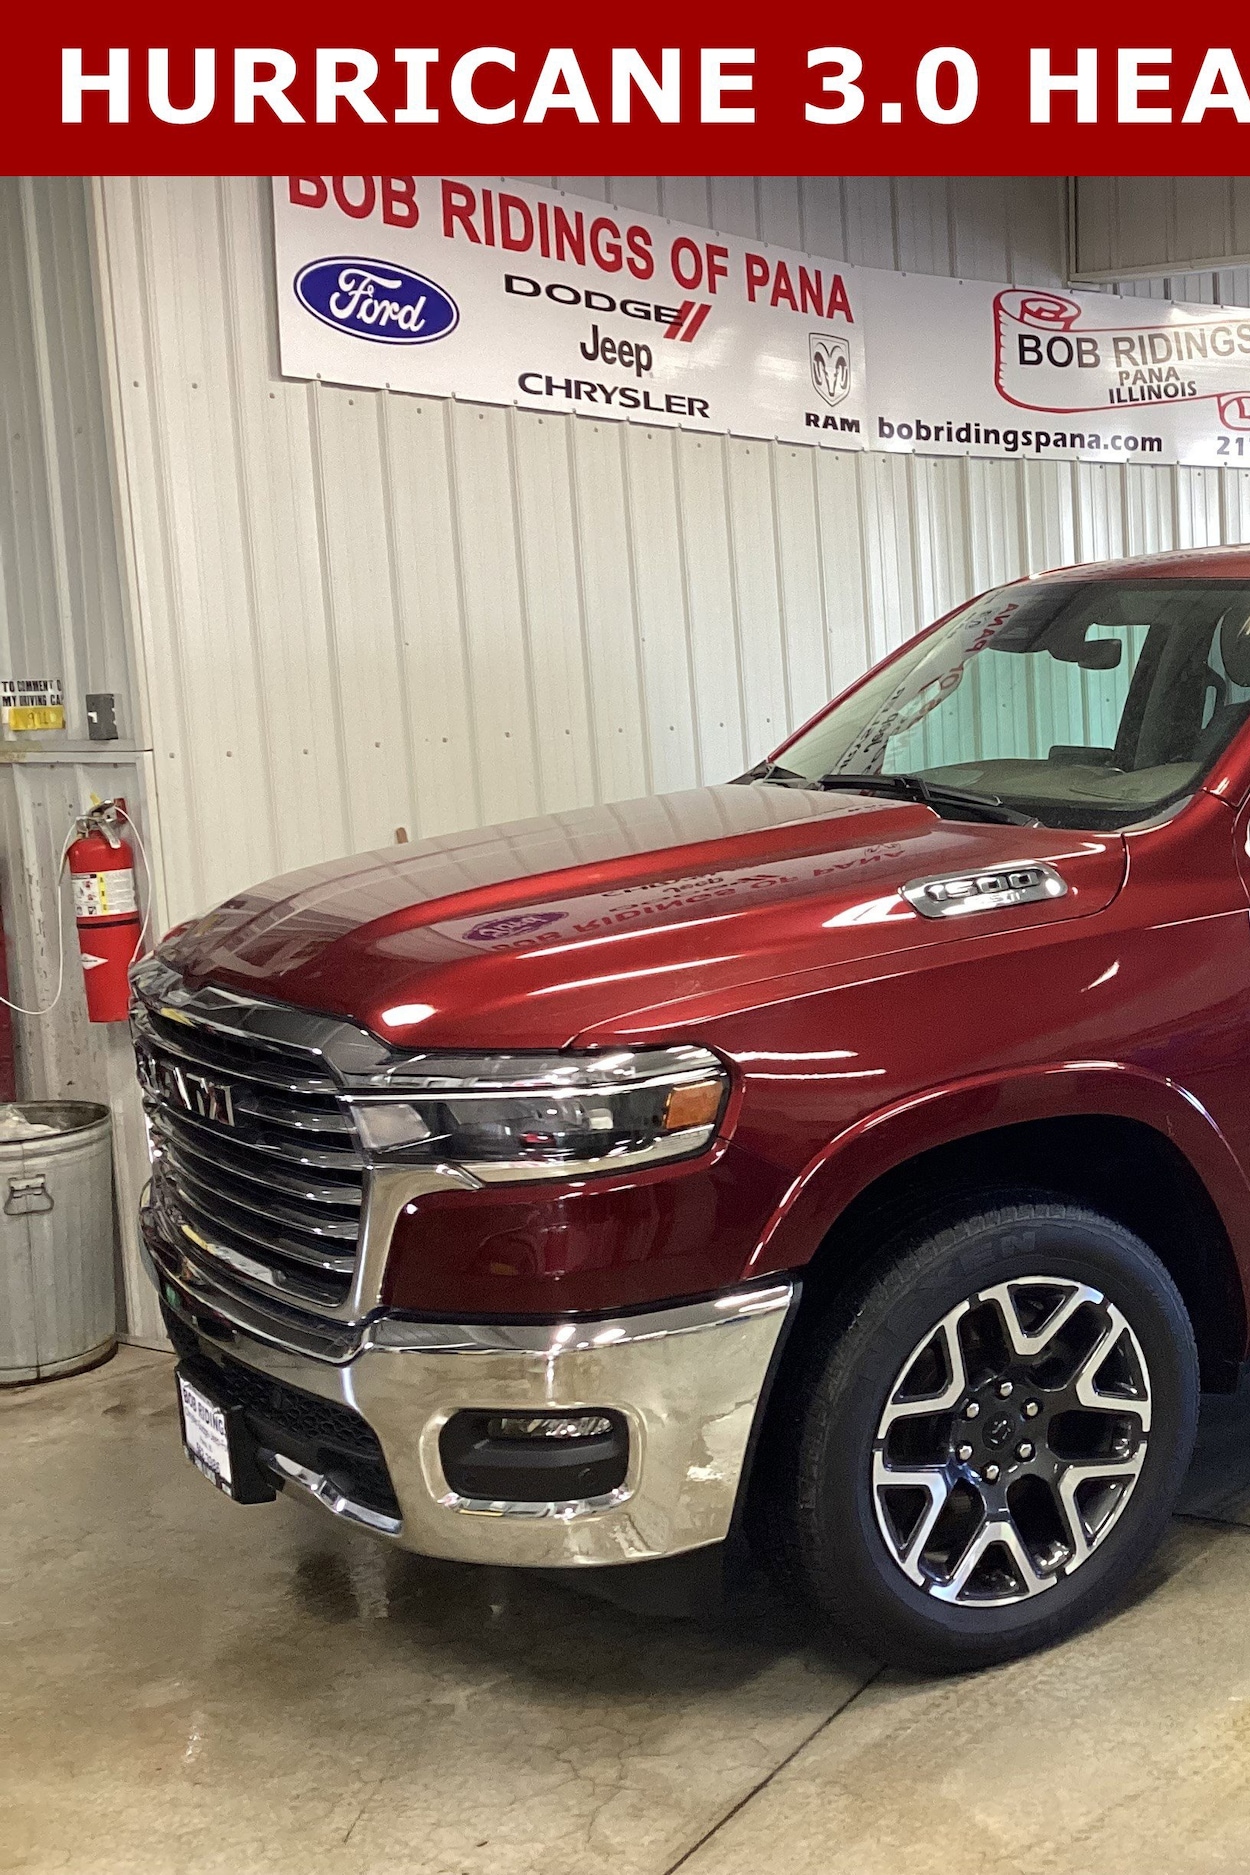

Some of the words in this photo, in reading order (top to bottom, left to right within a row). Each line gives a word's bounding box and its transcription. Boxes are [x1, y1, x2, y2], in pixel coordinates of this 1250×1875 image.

[441, 179, 654, 280] RIDINGS
[670, 237, 728, 294] OF
[745, 253, 854, 323] PANA
[329, 267, 426, 332] Ford
[503, 273, 685, 327] DODGE
[579, 324, 653, 376] Jeep
[1017, 333, 1101, 369] BOB
[1108, 380, 1198, 404] ILLINOIS
[1118, 366, 1180, 387] PANA
[517, 371, 711, 419] CHRYSLER
[805, 412, 860, 434] RAM
[877, 416, 1163, 454] bobridingspana.com
[1, 680, 15, 692] TO
[2, 695, 16, 707] MY
[925, 870, 1040, 901] 1500
